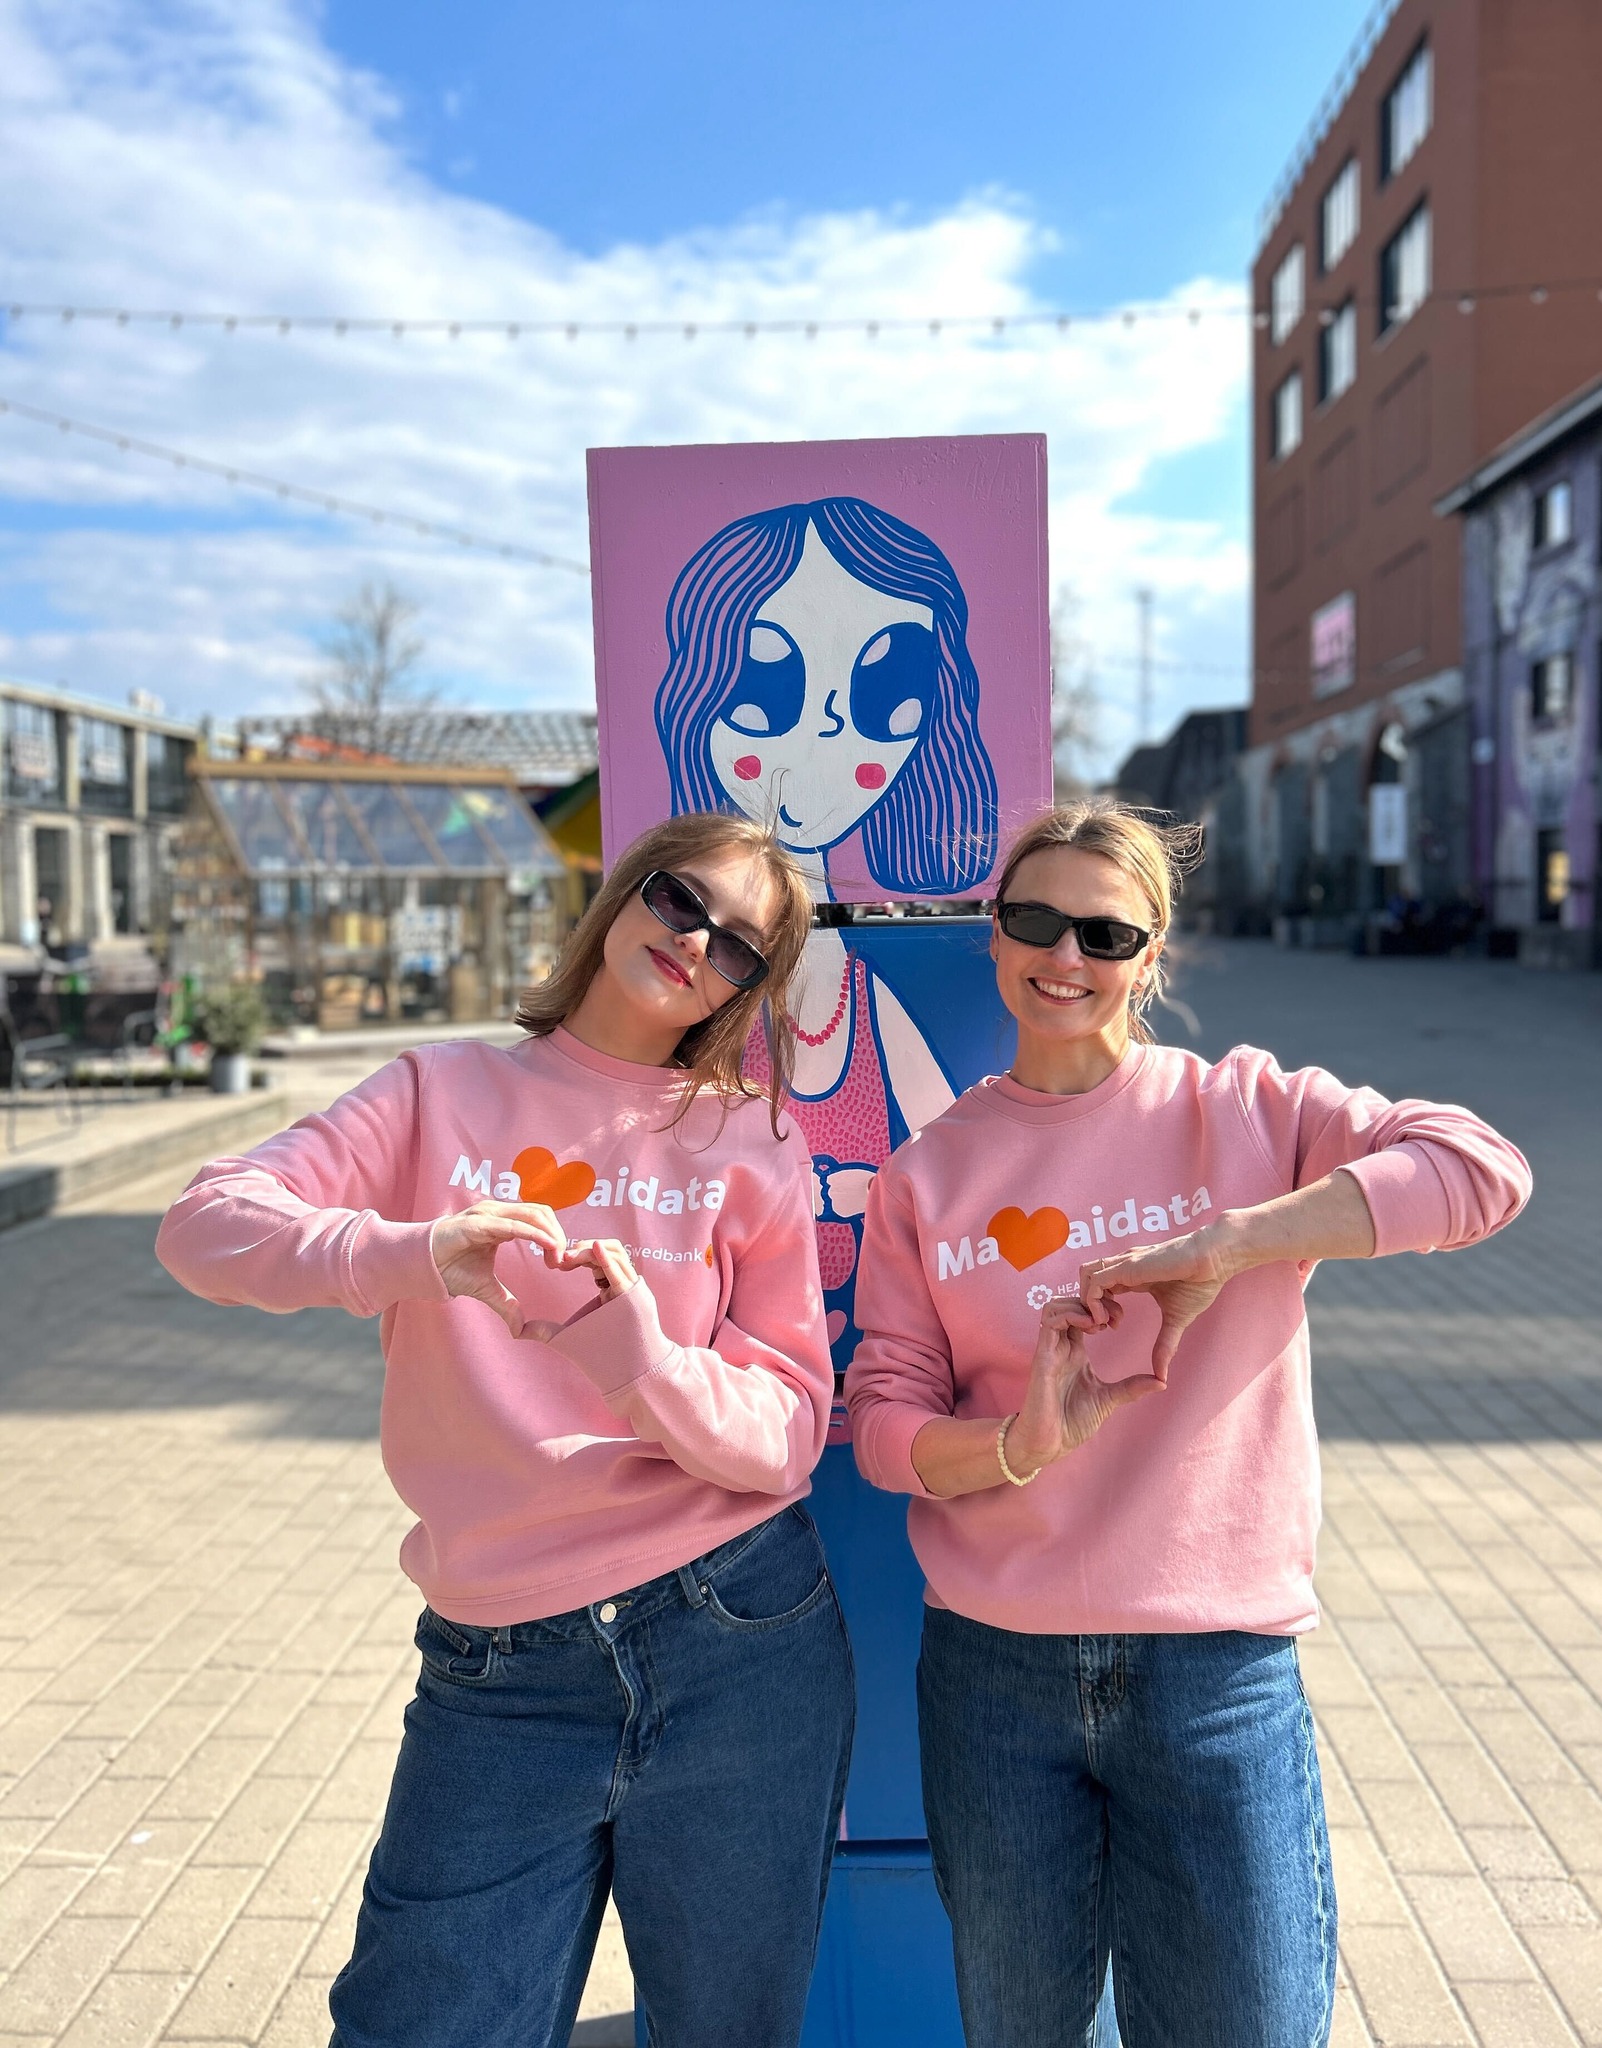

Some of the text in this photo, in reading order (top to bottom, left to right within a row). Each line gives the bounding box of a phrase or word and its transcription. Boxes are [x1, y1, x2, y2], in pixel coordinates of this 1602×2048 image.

[448, 1154, 726, 1215] Ma aidata
[624, 1243, 703, 1263] Swedbank
[937, 1185, 1212, 1281] Ma aidata
